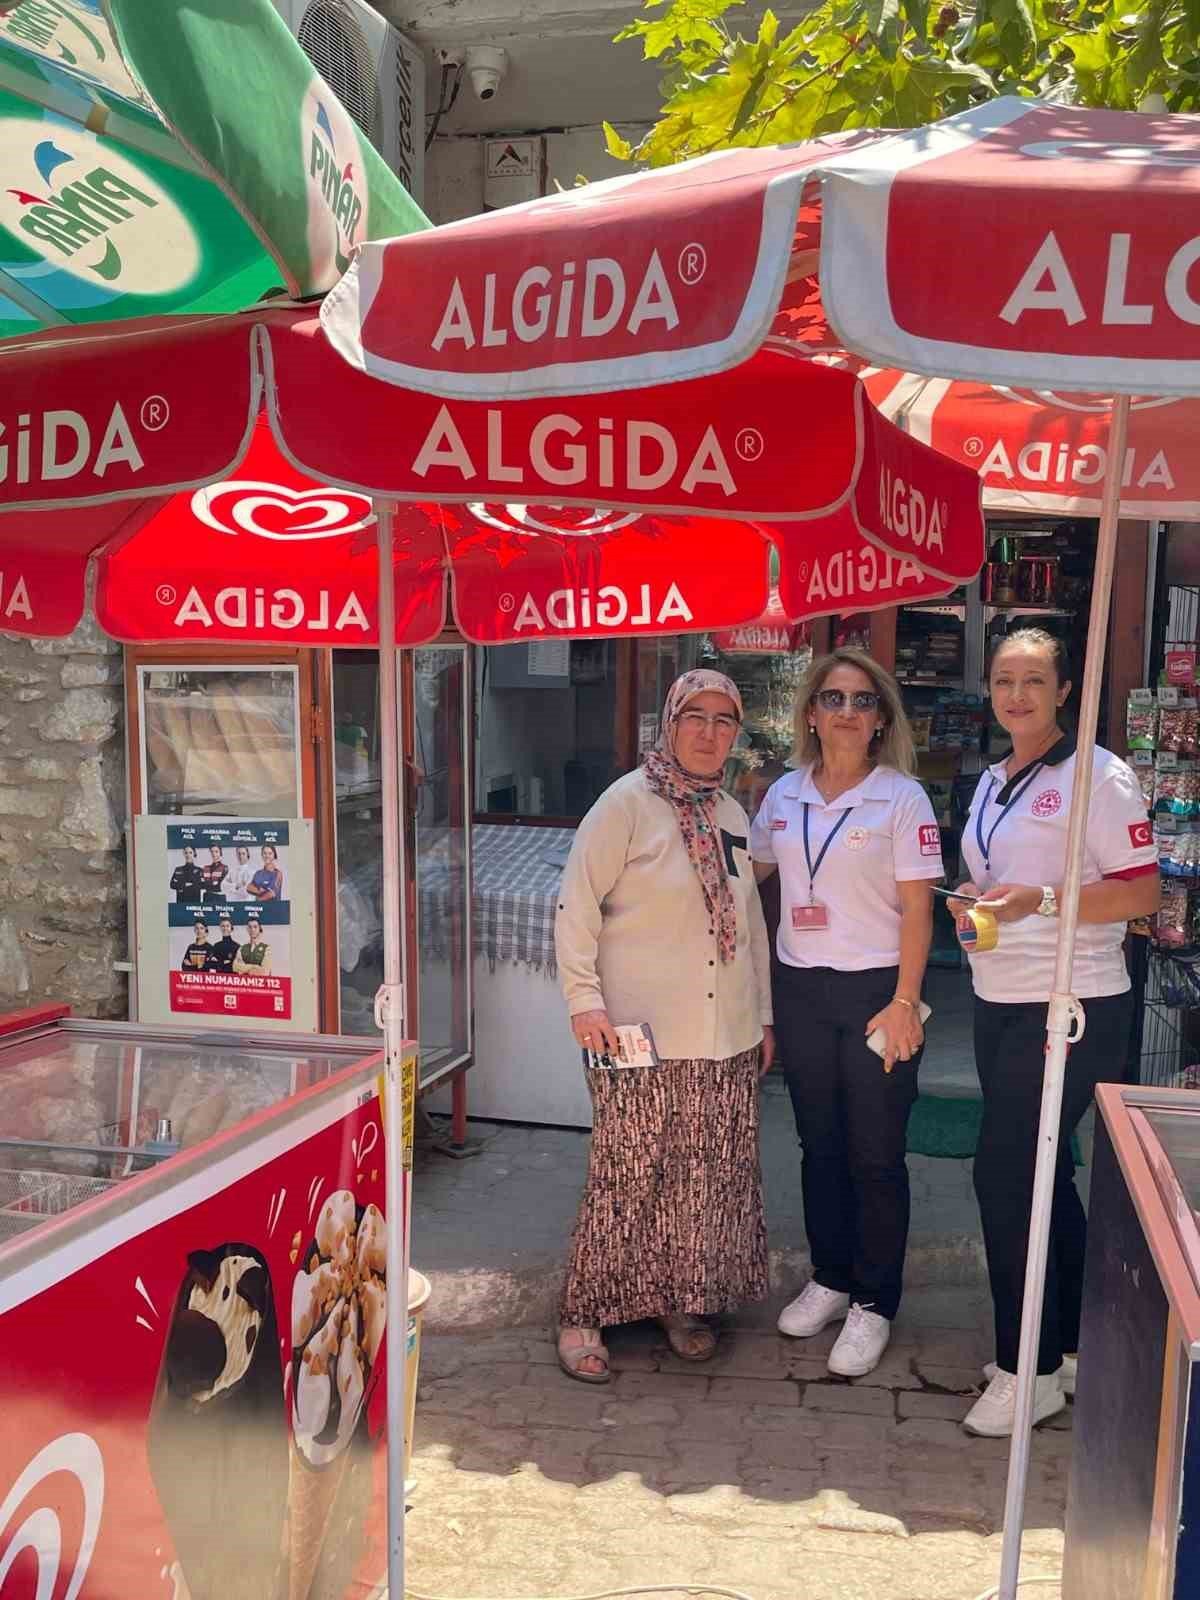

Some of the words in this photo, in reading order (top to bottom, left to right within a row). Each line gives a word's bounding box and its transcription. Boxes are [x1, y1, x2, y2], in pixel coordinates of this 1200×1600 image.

[310, 130, 362, 248] PINAR
[0, 401, 145, 484] iDA
[922, 828, 940, 842] 112
[266, 978, 281, 989] 112
